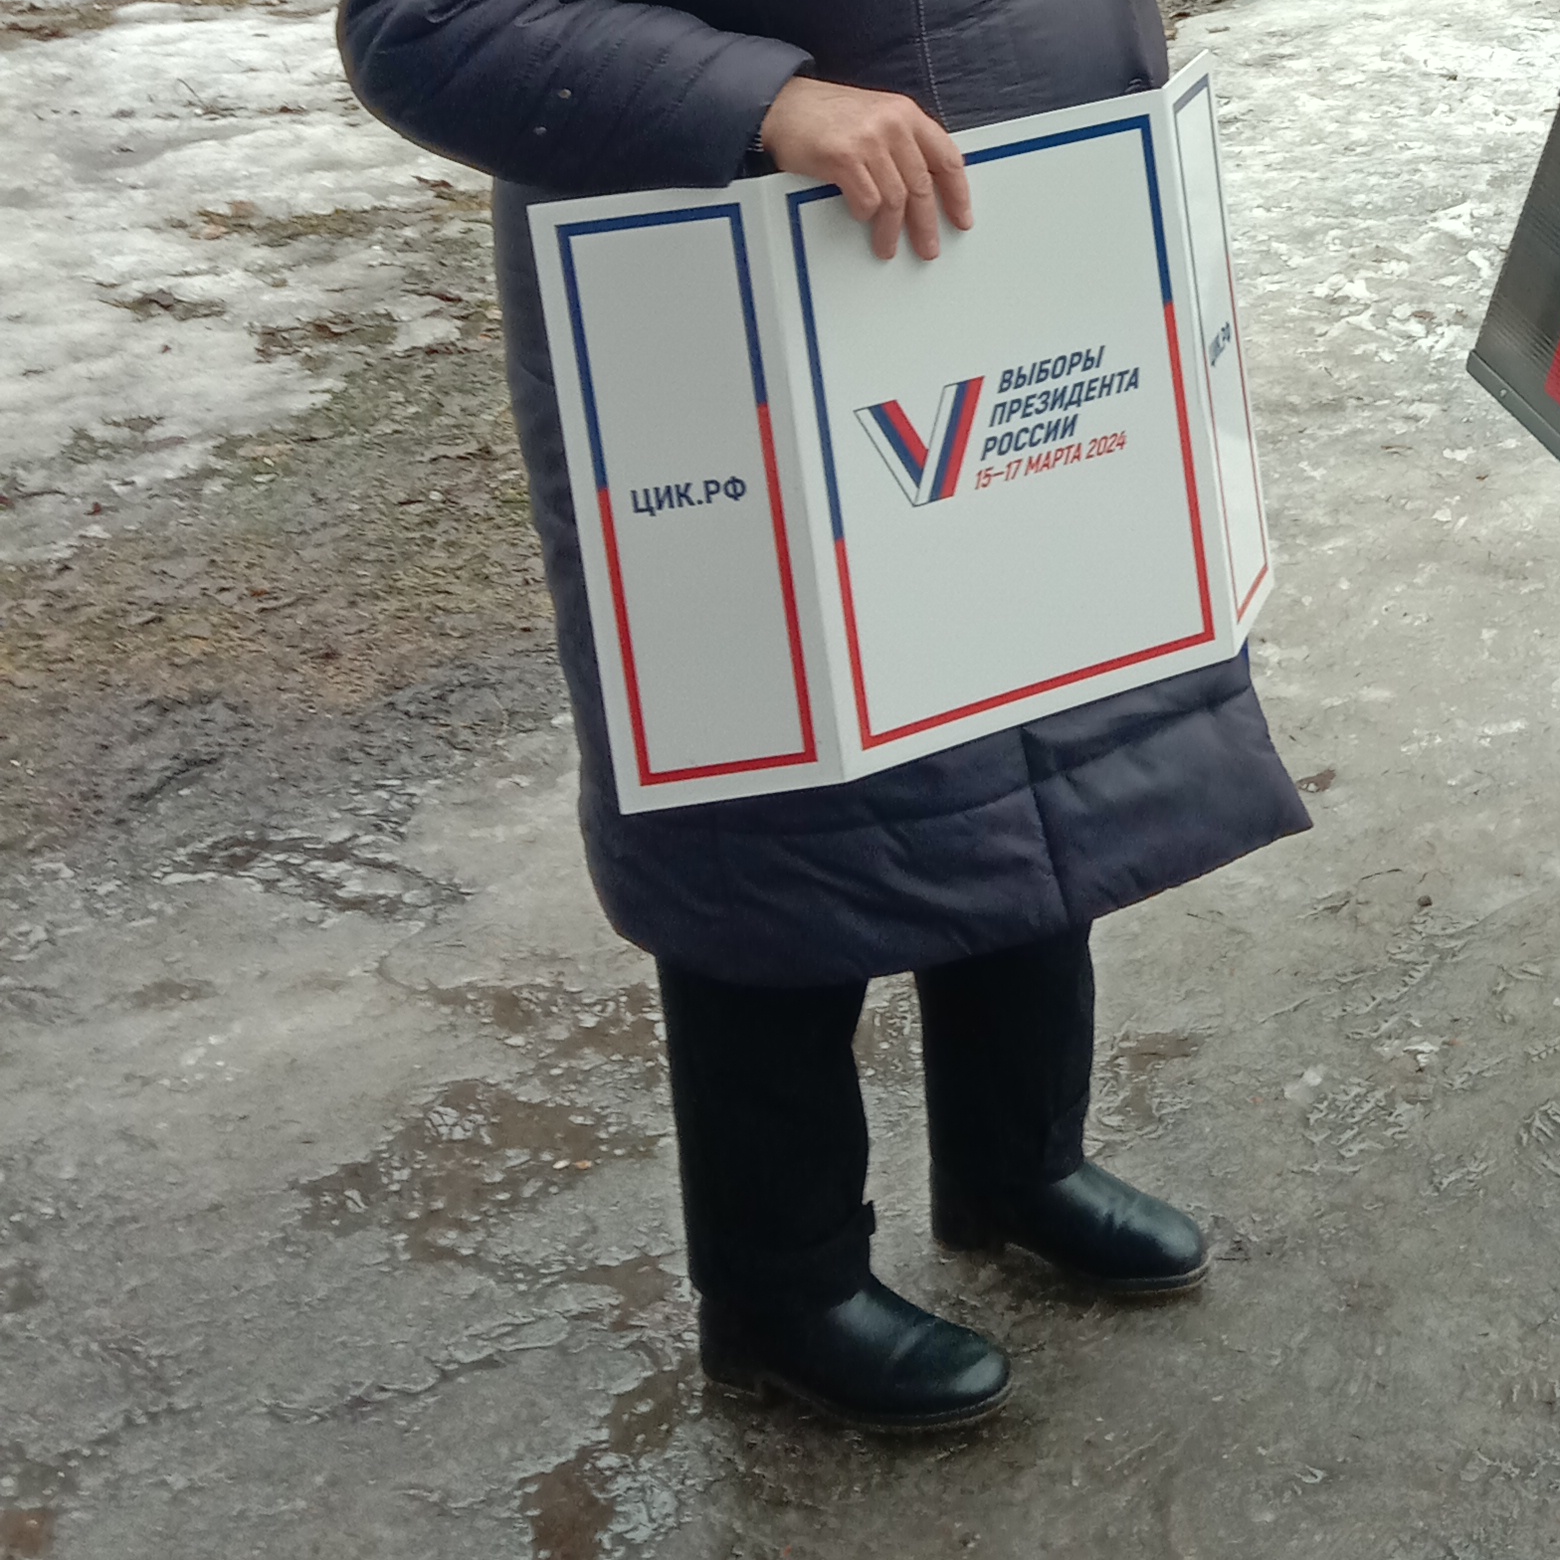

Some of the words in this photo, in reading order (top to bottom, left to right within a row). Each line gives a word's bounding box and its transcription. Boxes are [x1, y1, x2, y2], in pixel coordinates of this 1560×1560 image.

[997, 345, 1106, 394] ВЫБОРЫ
[988, 367, 1140, 428] ПРЕЗИДЕНТА
[980, 413, 1079, 462] РОССИИ
[1023, 442, 1082, 476] МАРТА
[1085, 430, 1127, 461] 2024
[629, 475, 747, 517] ЦИК.РФ
